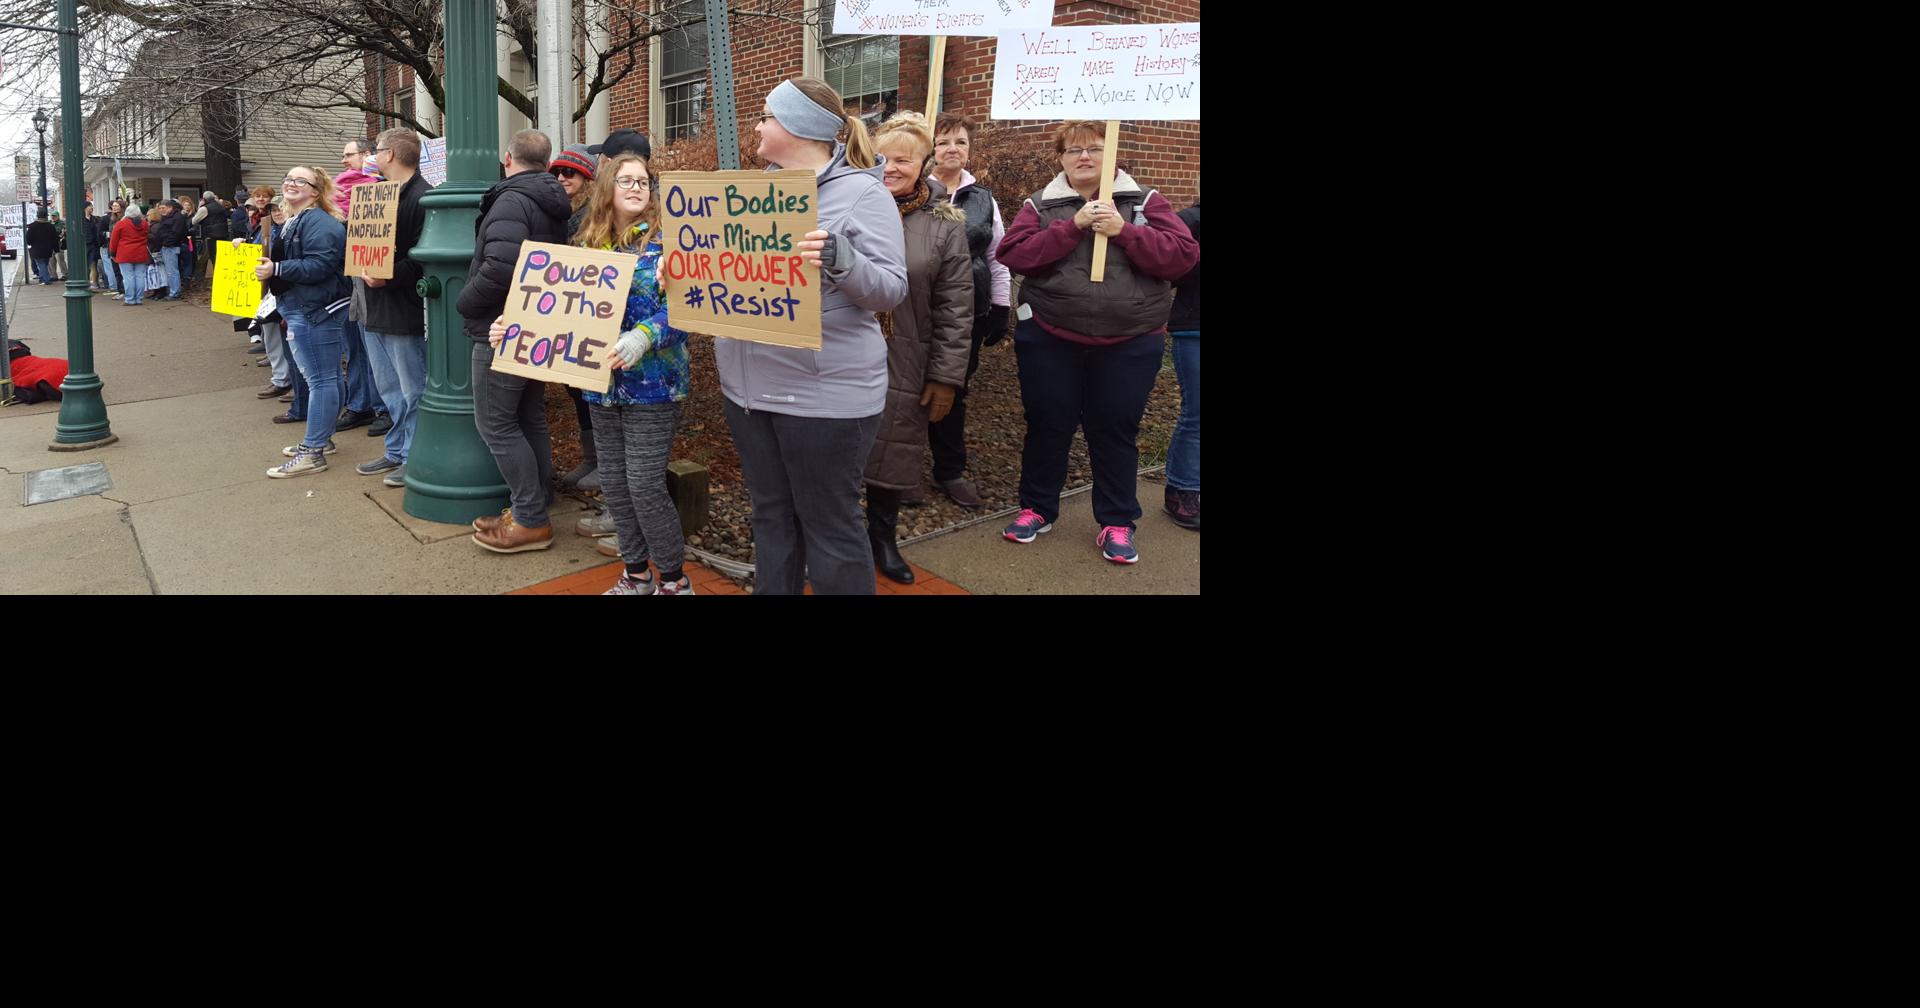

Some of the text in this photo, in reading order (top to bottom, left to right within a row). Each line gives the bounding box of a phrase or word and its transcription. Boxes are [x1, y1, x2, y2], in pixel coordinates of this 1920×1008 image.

[1022, 32, 1077, 55] WELL
[1087, 31, 1148, 51] BEHAVED
[1081, 61, 1115, 77] MAKE
[1073, 87, 1087, 103] A
[1146, 82, 1195, 106] NOW
[356, 183, 399, 202] THE NIGHT
[666, 183, 810, 218] Our Bodies
[352, 203, 386, 220] IS DARK
[678, 221, 793, 253] Our Minds
[352, 244, 390, 267] TRUMP
[667, 249, 807, 287] OUR POWER
[227, 288, 252, 307] ALL
[520, 285, 557, 315] TO
[684, 282, 801, 322] #Resist
[499, 323, 608, 370] PEOPLE
